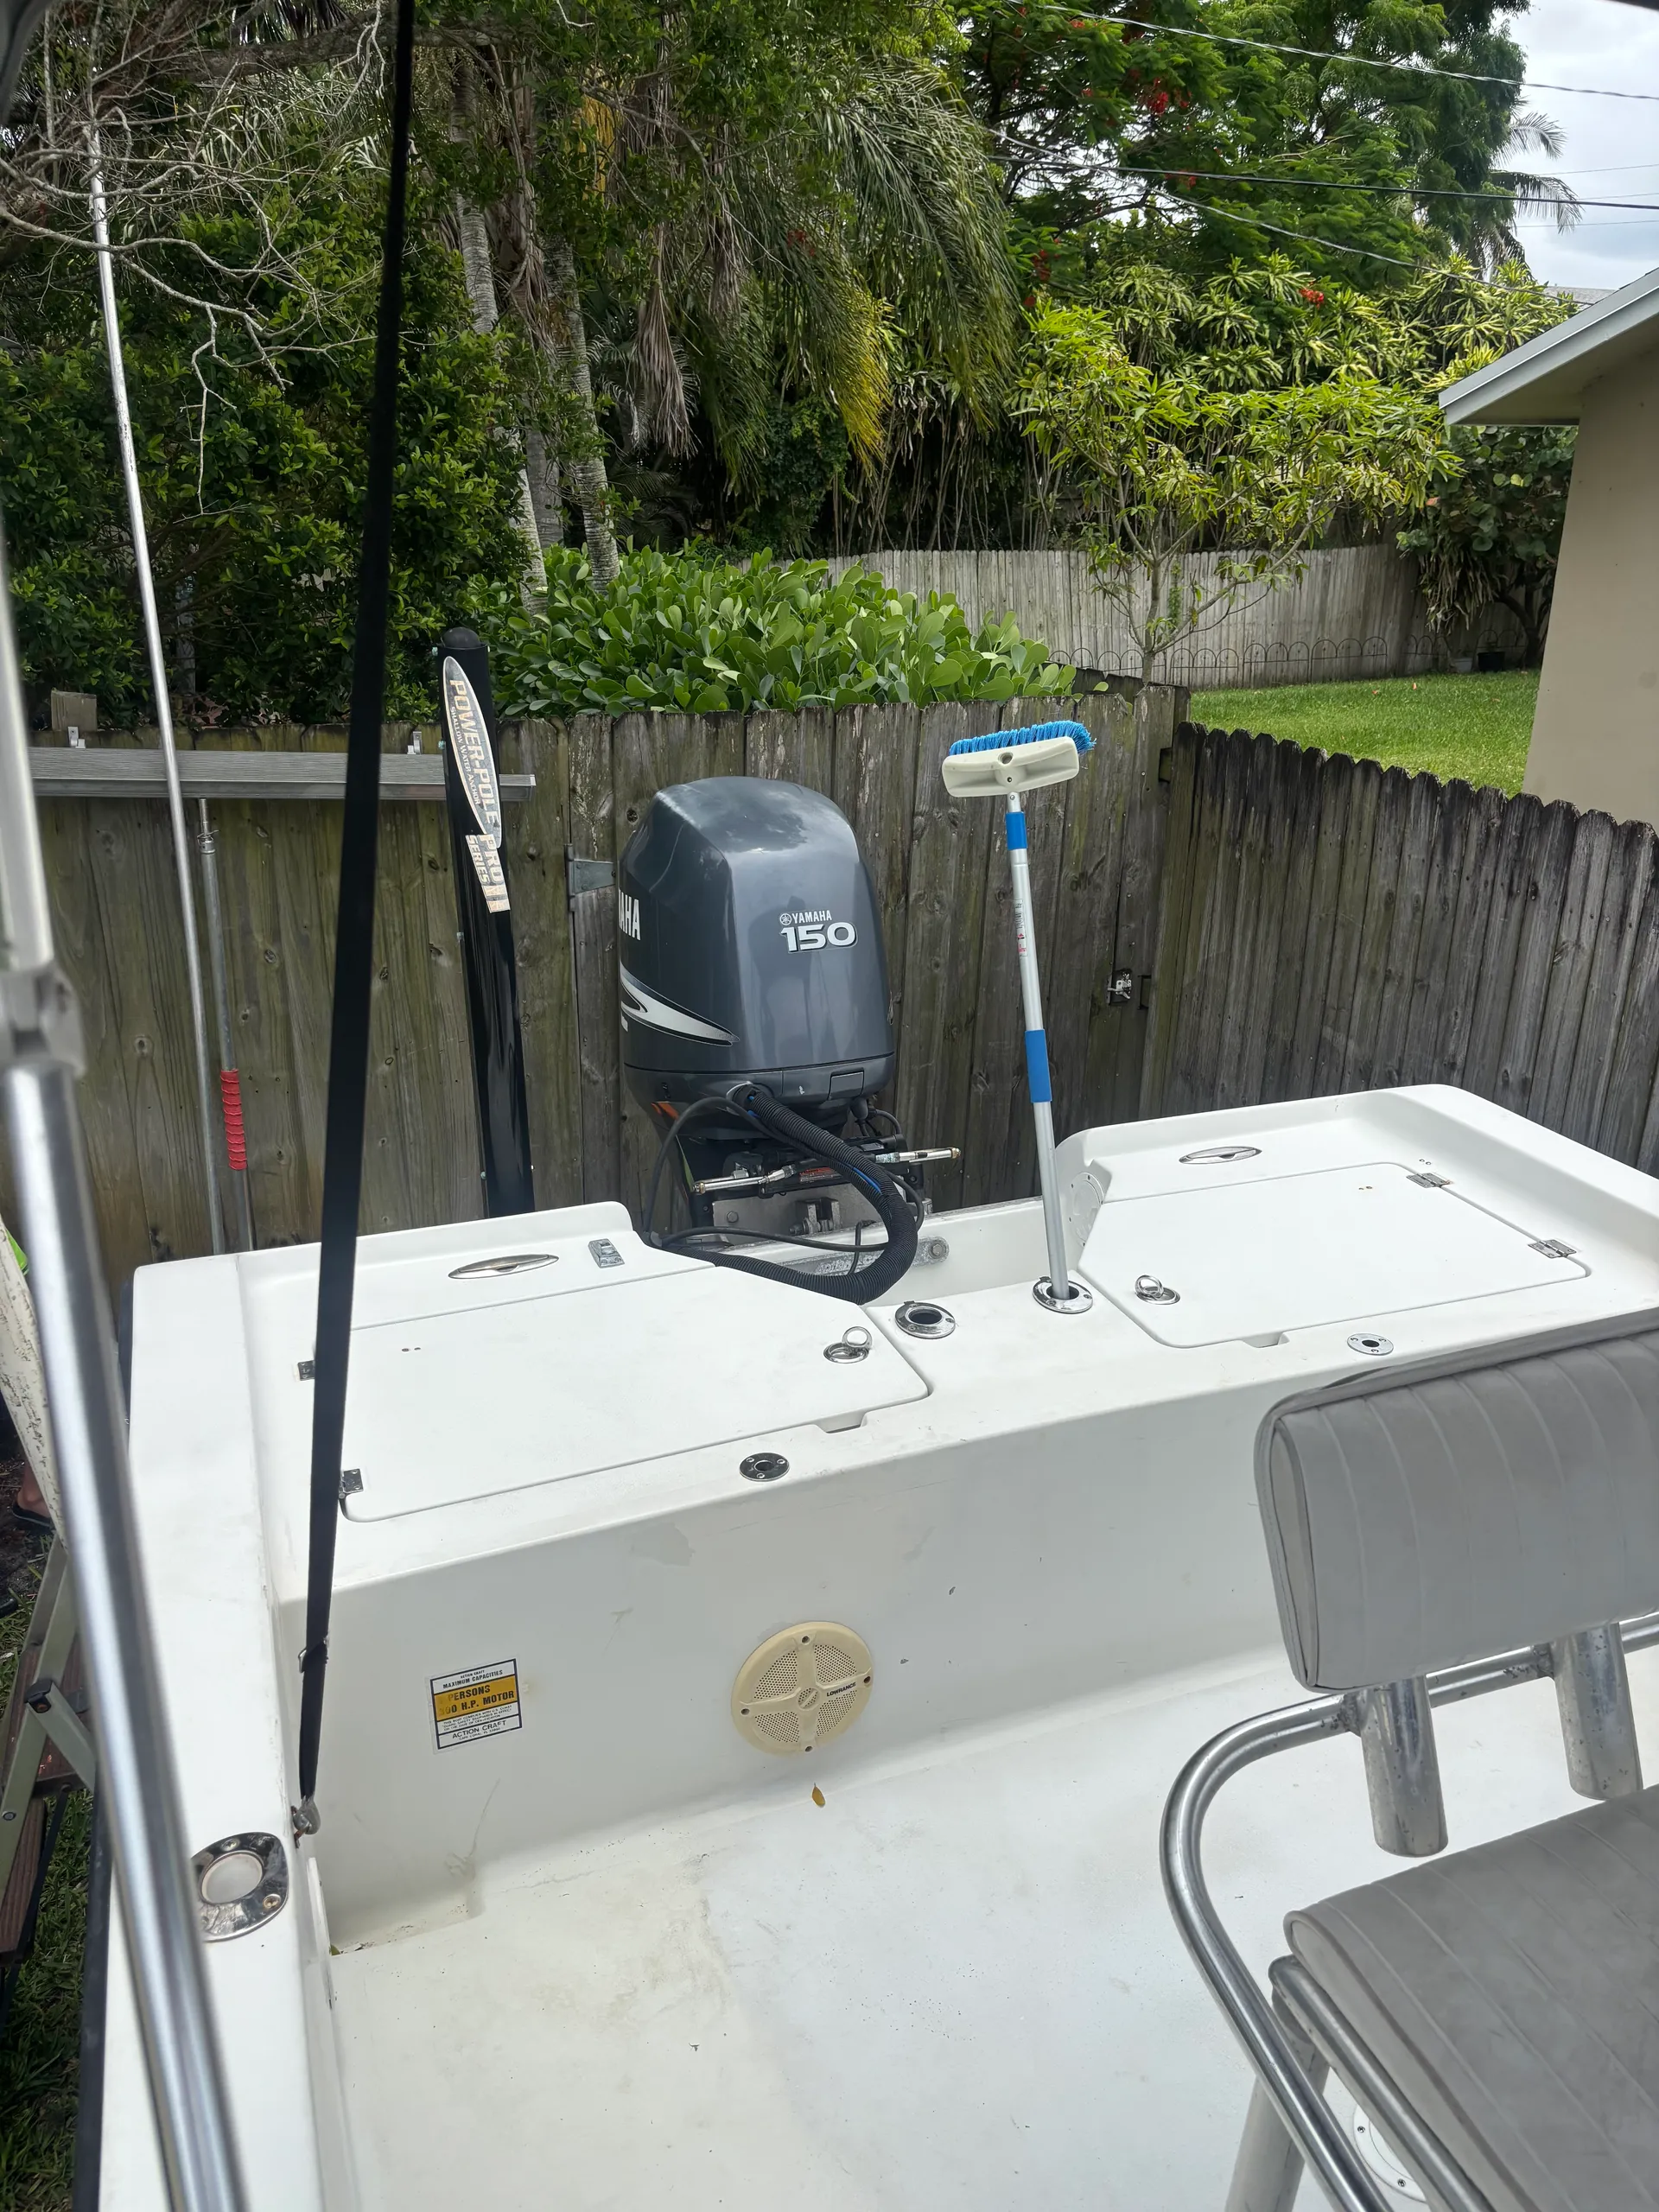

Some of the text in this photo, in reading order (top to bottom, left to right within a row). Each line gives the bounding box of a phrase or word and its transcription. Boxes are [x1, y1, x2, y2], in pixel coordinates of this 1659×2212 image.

[449, 680, 499, 823] POWER-POLE
[450, 706, 481, 804] SHALLOW WATER ANCHOR
[467, 835, 491, 883] SERIES
[479, 834, 505, 884] PRO
[792, 910, 832, 924] YAMAHA
[780, 922, 856, 952] 150
[442, 1669, 503, 1689] MAXIMUM CAPACITIES
[826, 1681, 856, 1697] LOWRANCE
[448, 1684, 491, 1701] PERSONS
[461, 1700, 480, 1711] H.P.
[483, 1690, 514, 1705] MOTOR
[452, 1719, 506, 1738] ACTION CRAFT
